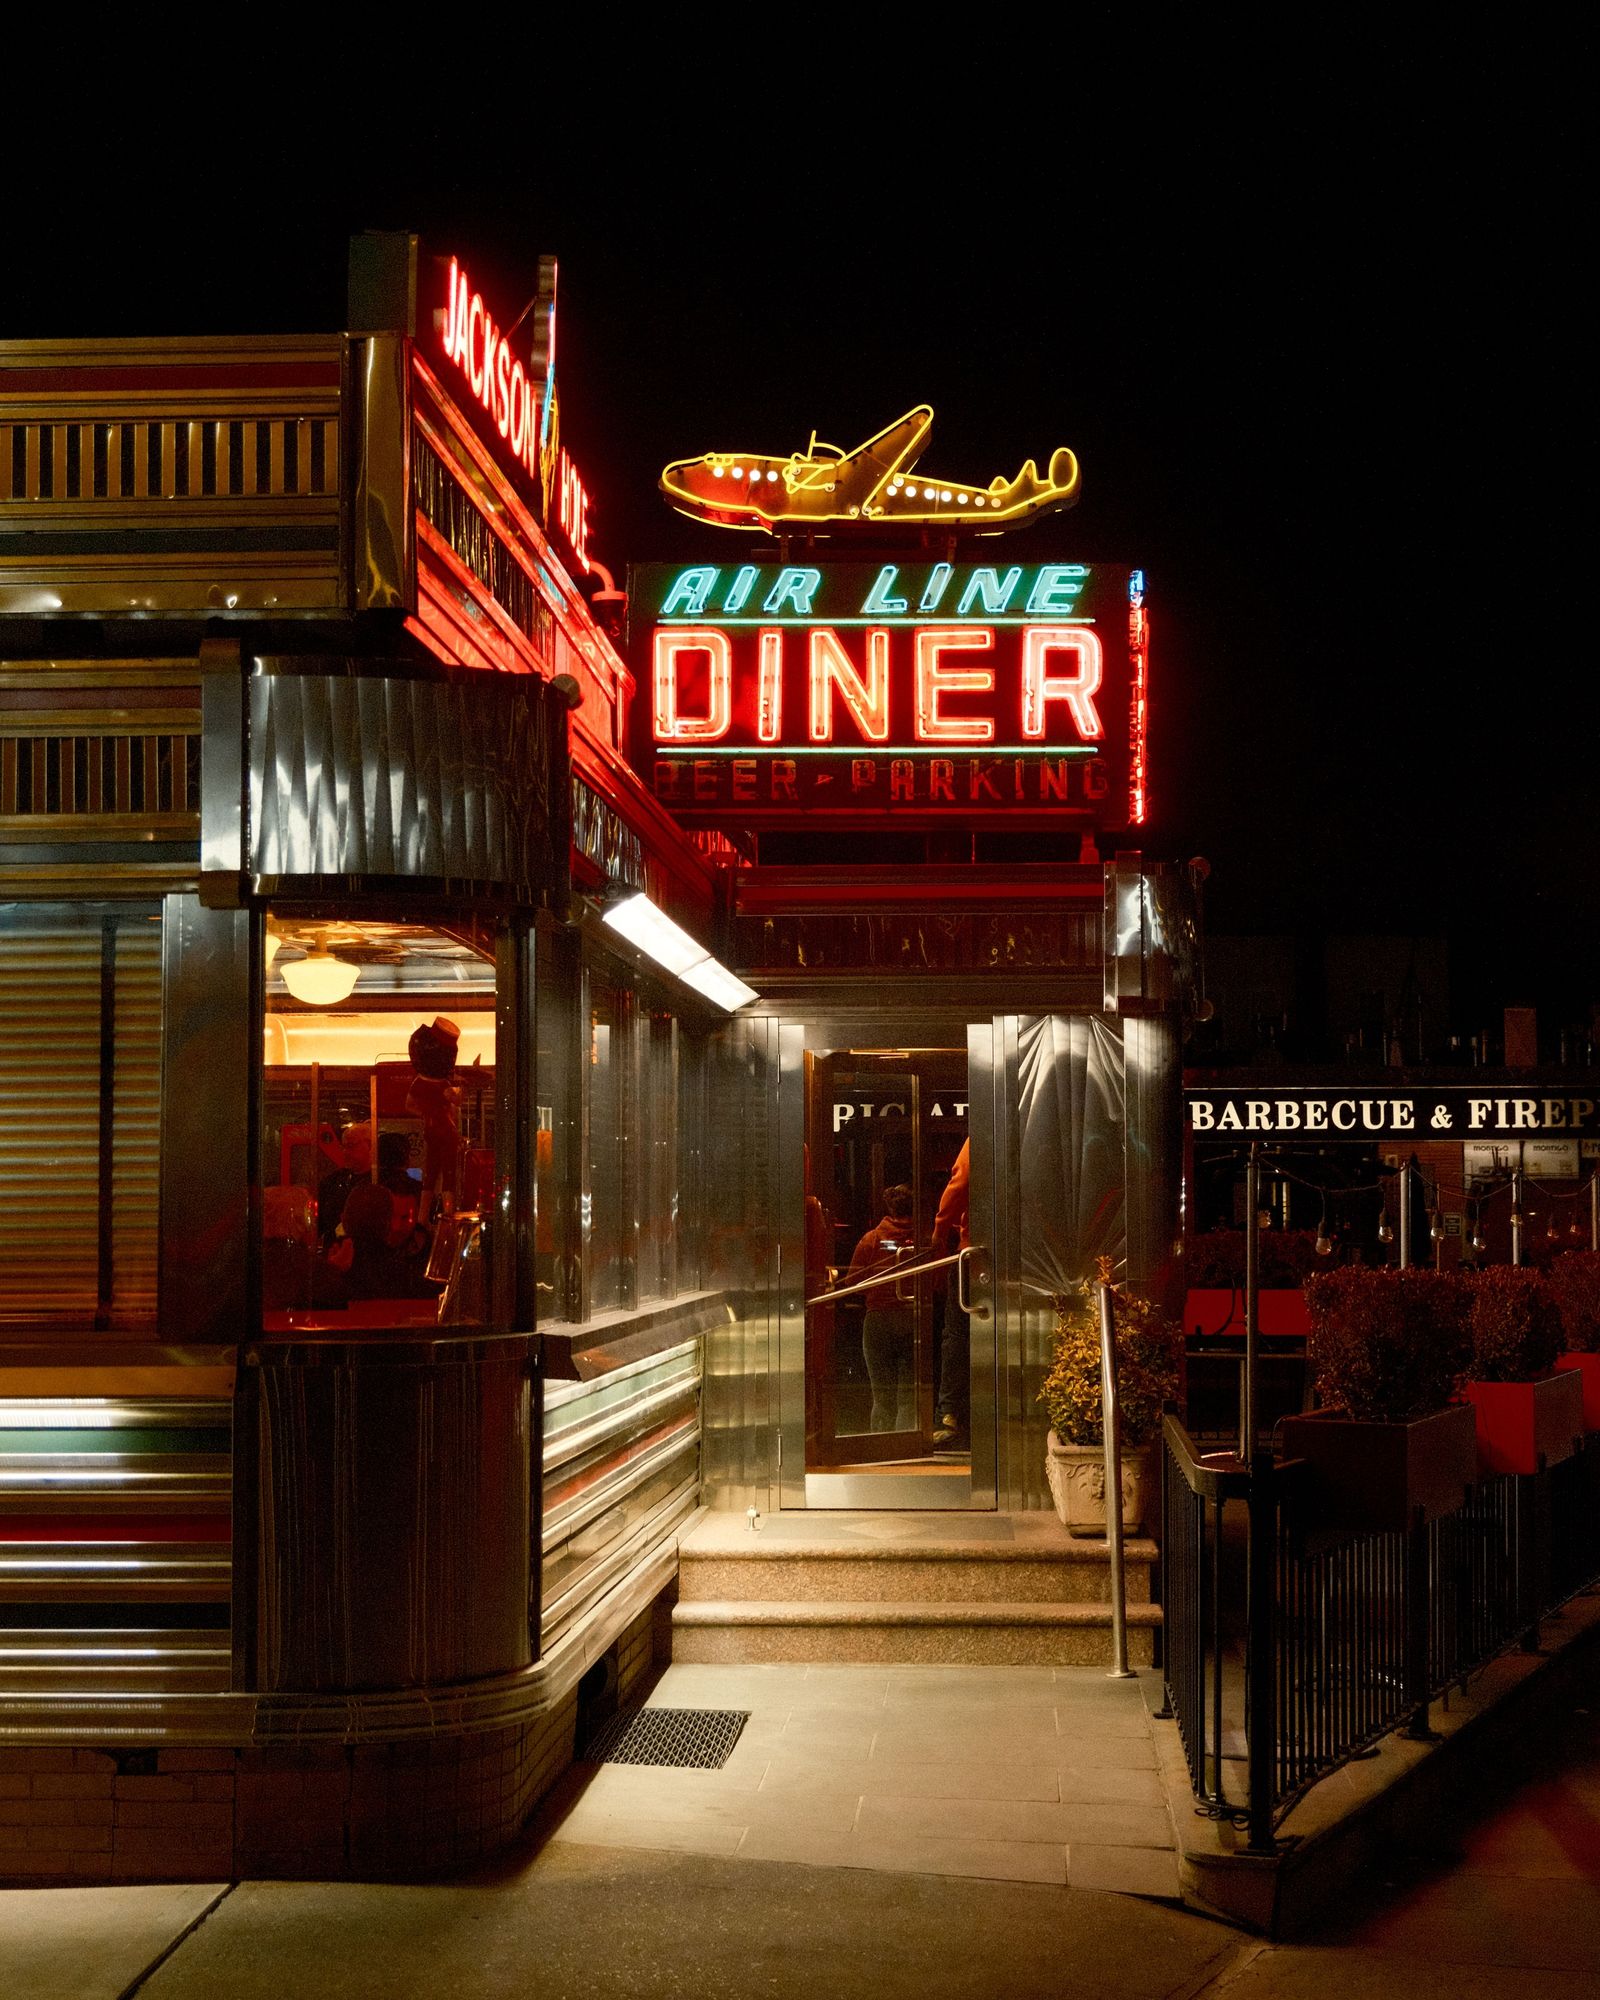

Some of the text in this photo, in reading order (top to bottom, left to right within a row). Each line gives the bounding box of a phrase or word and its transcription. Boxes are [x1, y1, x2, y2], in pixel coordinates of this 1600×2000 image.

[442, 254, 593, 575] JACKSON HOLE
[658, 563, 1092, 614] AIR LINE
[653, 626, 1105, 742] DINER
[655, 757, 1110, 800] BEER PARKING
[1189, 1099, 1600, 1130] BARBECUE & FIREP
